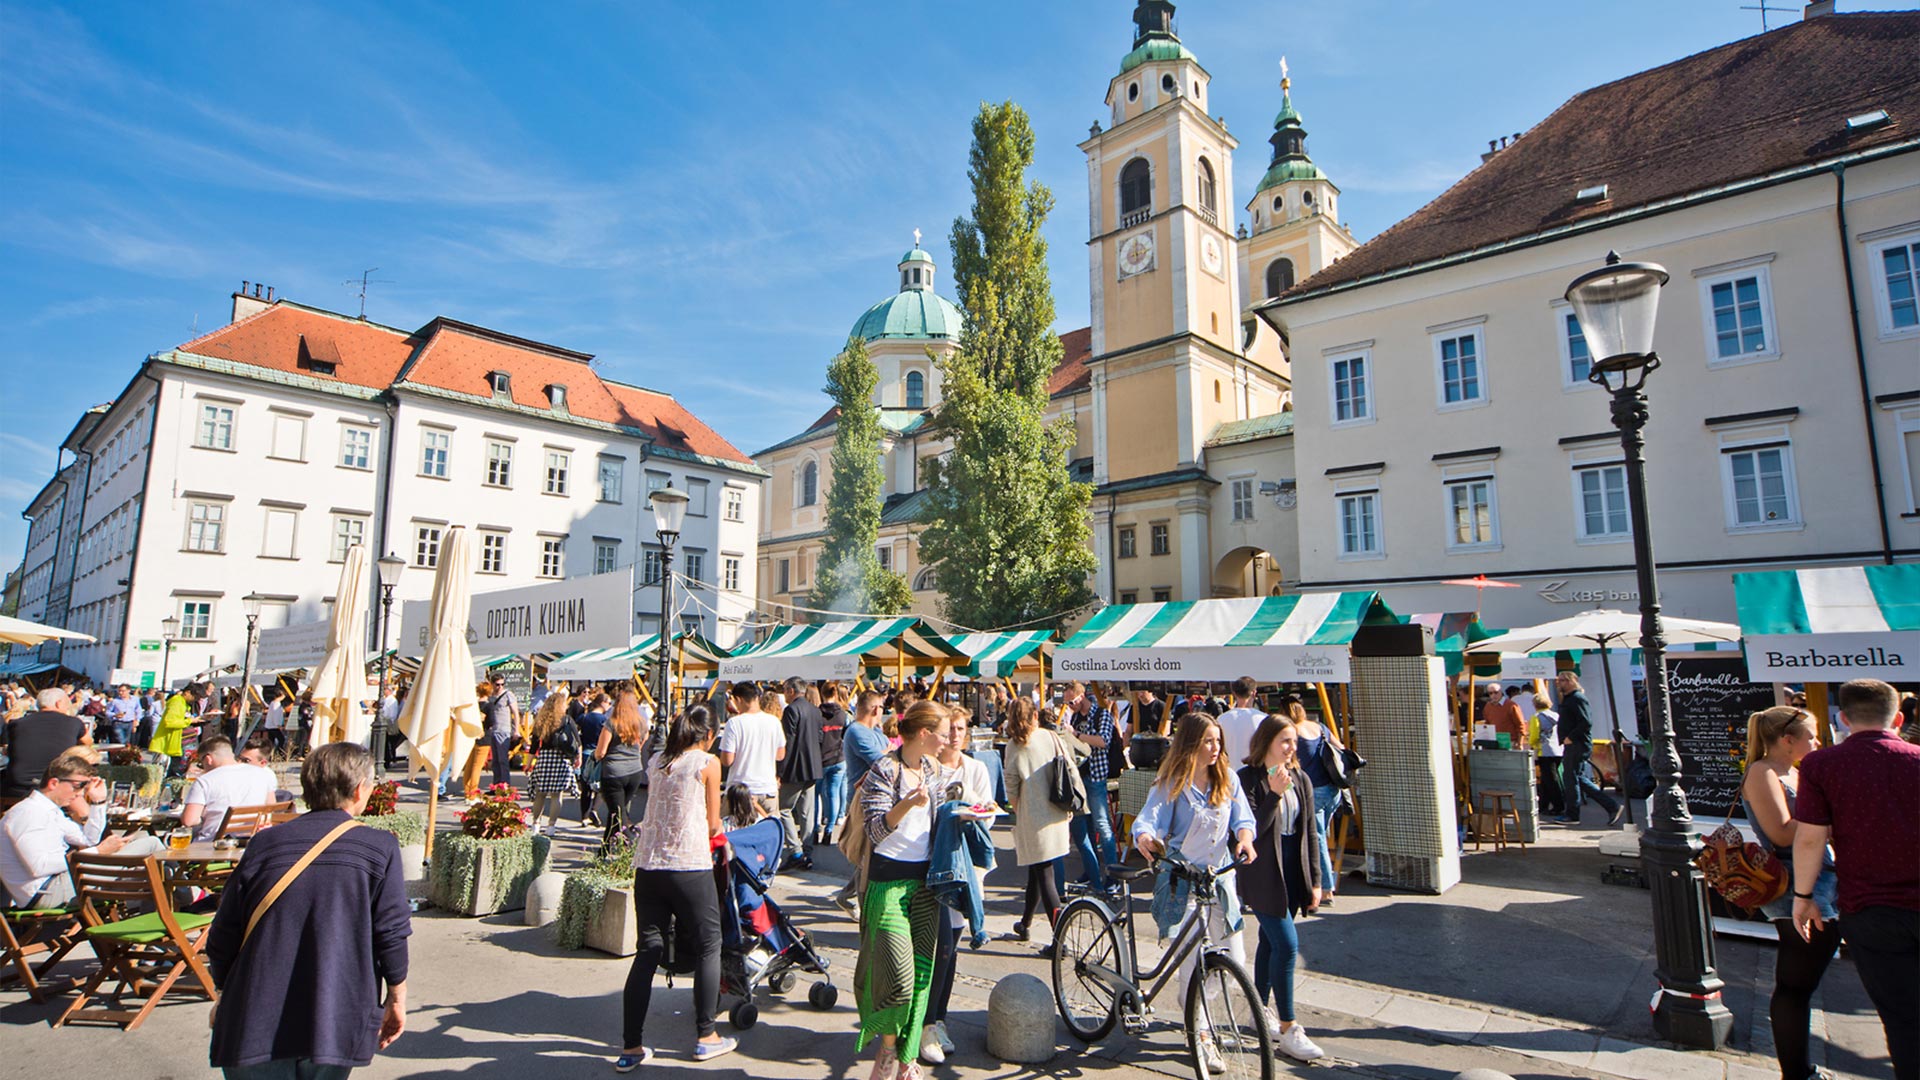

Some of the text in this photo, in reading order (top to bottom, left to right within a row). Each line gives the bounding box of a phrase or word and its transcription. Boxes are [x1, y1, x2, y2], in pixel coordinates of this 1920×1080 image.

[1569, 590, 1604, 602] KBS
[486, 598, 585, 639] ODPRTA KUHNA
[1061, 658, 1182, 671] Gostilna Lovski dom
[1766, 647, 1904, 667] Barbarella
